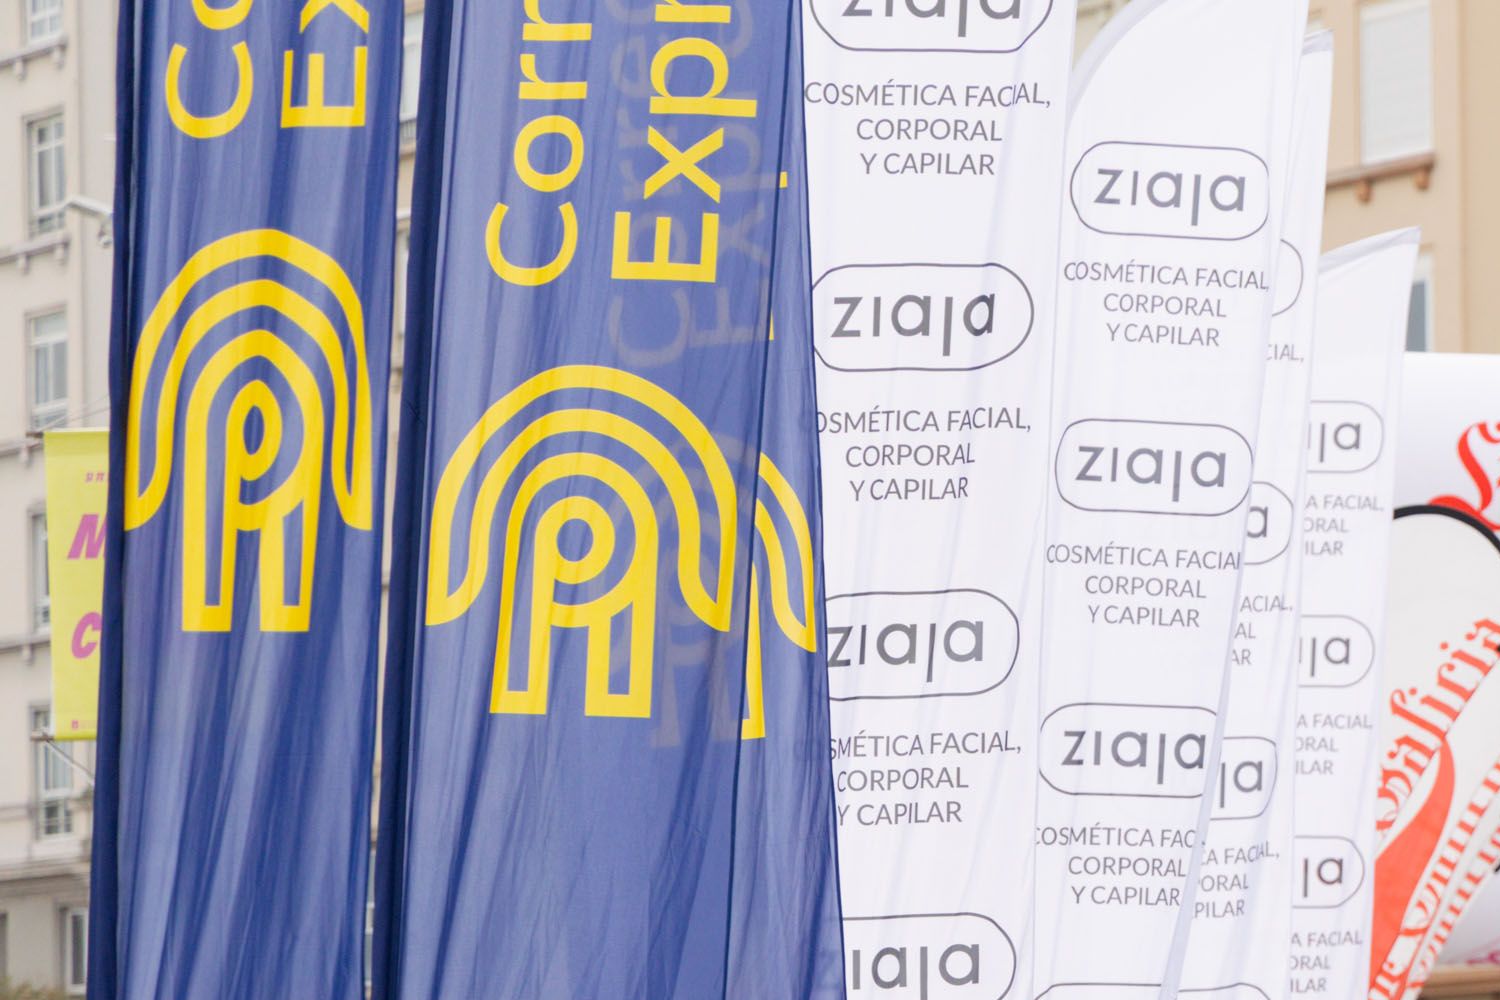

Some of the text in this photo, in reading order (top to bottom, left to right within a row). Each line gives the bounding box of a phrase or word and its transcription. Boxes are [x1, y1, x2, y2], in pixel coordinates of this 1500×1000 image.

[804, 79, 1050, 108] COSMÉTICA FACIAL,
[856, 119, 1002, 141] CORPORAL
[485, 0, 592, 286] Corr
[860, 153, 995, 175] Y CAPILAR
[1094, 168, 1246, 226] ziaja
[1064, 259, 1188, 286] COSMÉTICA
[1103, 293, 1227, 318] CORPORAL
[830, 293, 995, 356] ziaja
[1106, 323, 1220, 347] Y CAPILAR
[817, 405, 1031, 433] OSMÉTICA FACIAL,
[846, 443, 975, 467] CORPORAL
[1075, 445, 1226, 502] ziaja
[850, 477, 969, 500] Y CAPILAR
[1047, 541, 1168, 567] COSMÉTICA
[1305, 540, 1344, 556] ILAR
[1085, 575, 1206, 599] CORPORAL
[1239, 594, 1293, 613] ACIAL,
[1088, 605, 1200, 628] Y CAPILAR
[827, 620, 983, 682] ziaja
[831, 730, 1021, 760] SMÉTICA FACIAL,
[1061, 731, 1206, 785] ziaja
[1295, 759, 1334, 775] ILAR
[837, 767, 969, 792] CORPORAL
[857, 801, 962, 826] CAPILAR
[1160, 829, 1196, 848] FAC
[1068, 856, 1186, 878] CORPORAL
[1200, 874, 1248, 892] ORAL
[1072, 886, 1180, 907] Y CAPILAR
[1194, 899, 1245, 919] PILAR
[1290, 978, 1327, 993] ILAR
